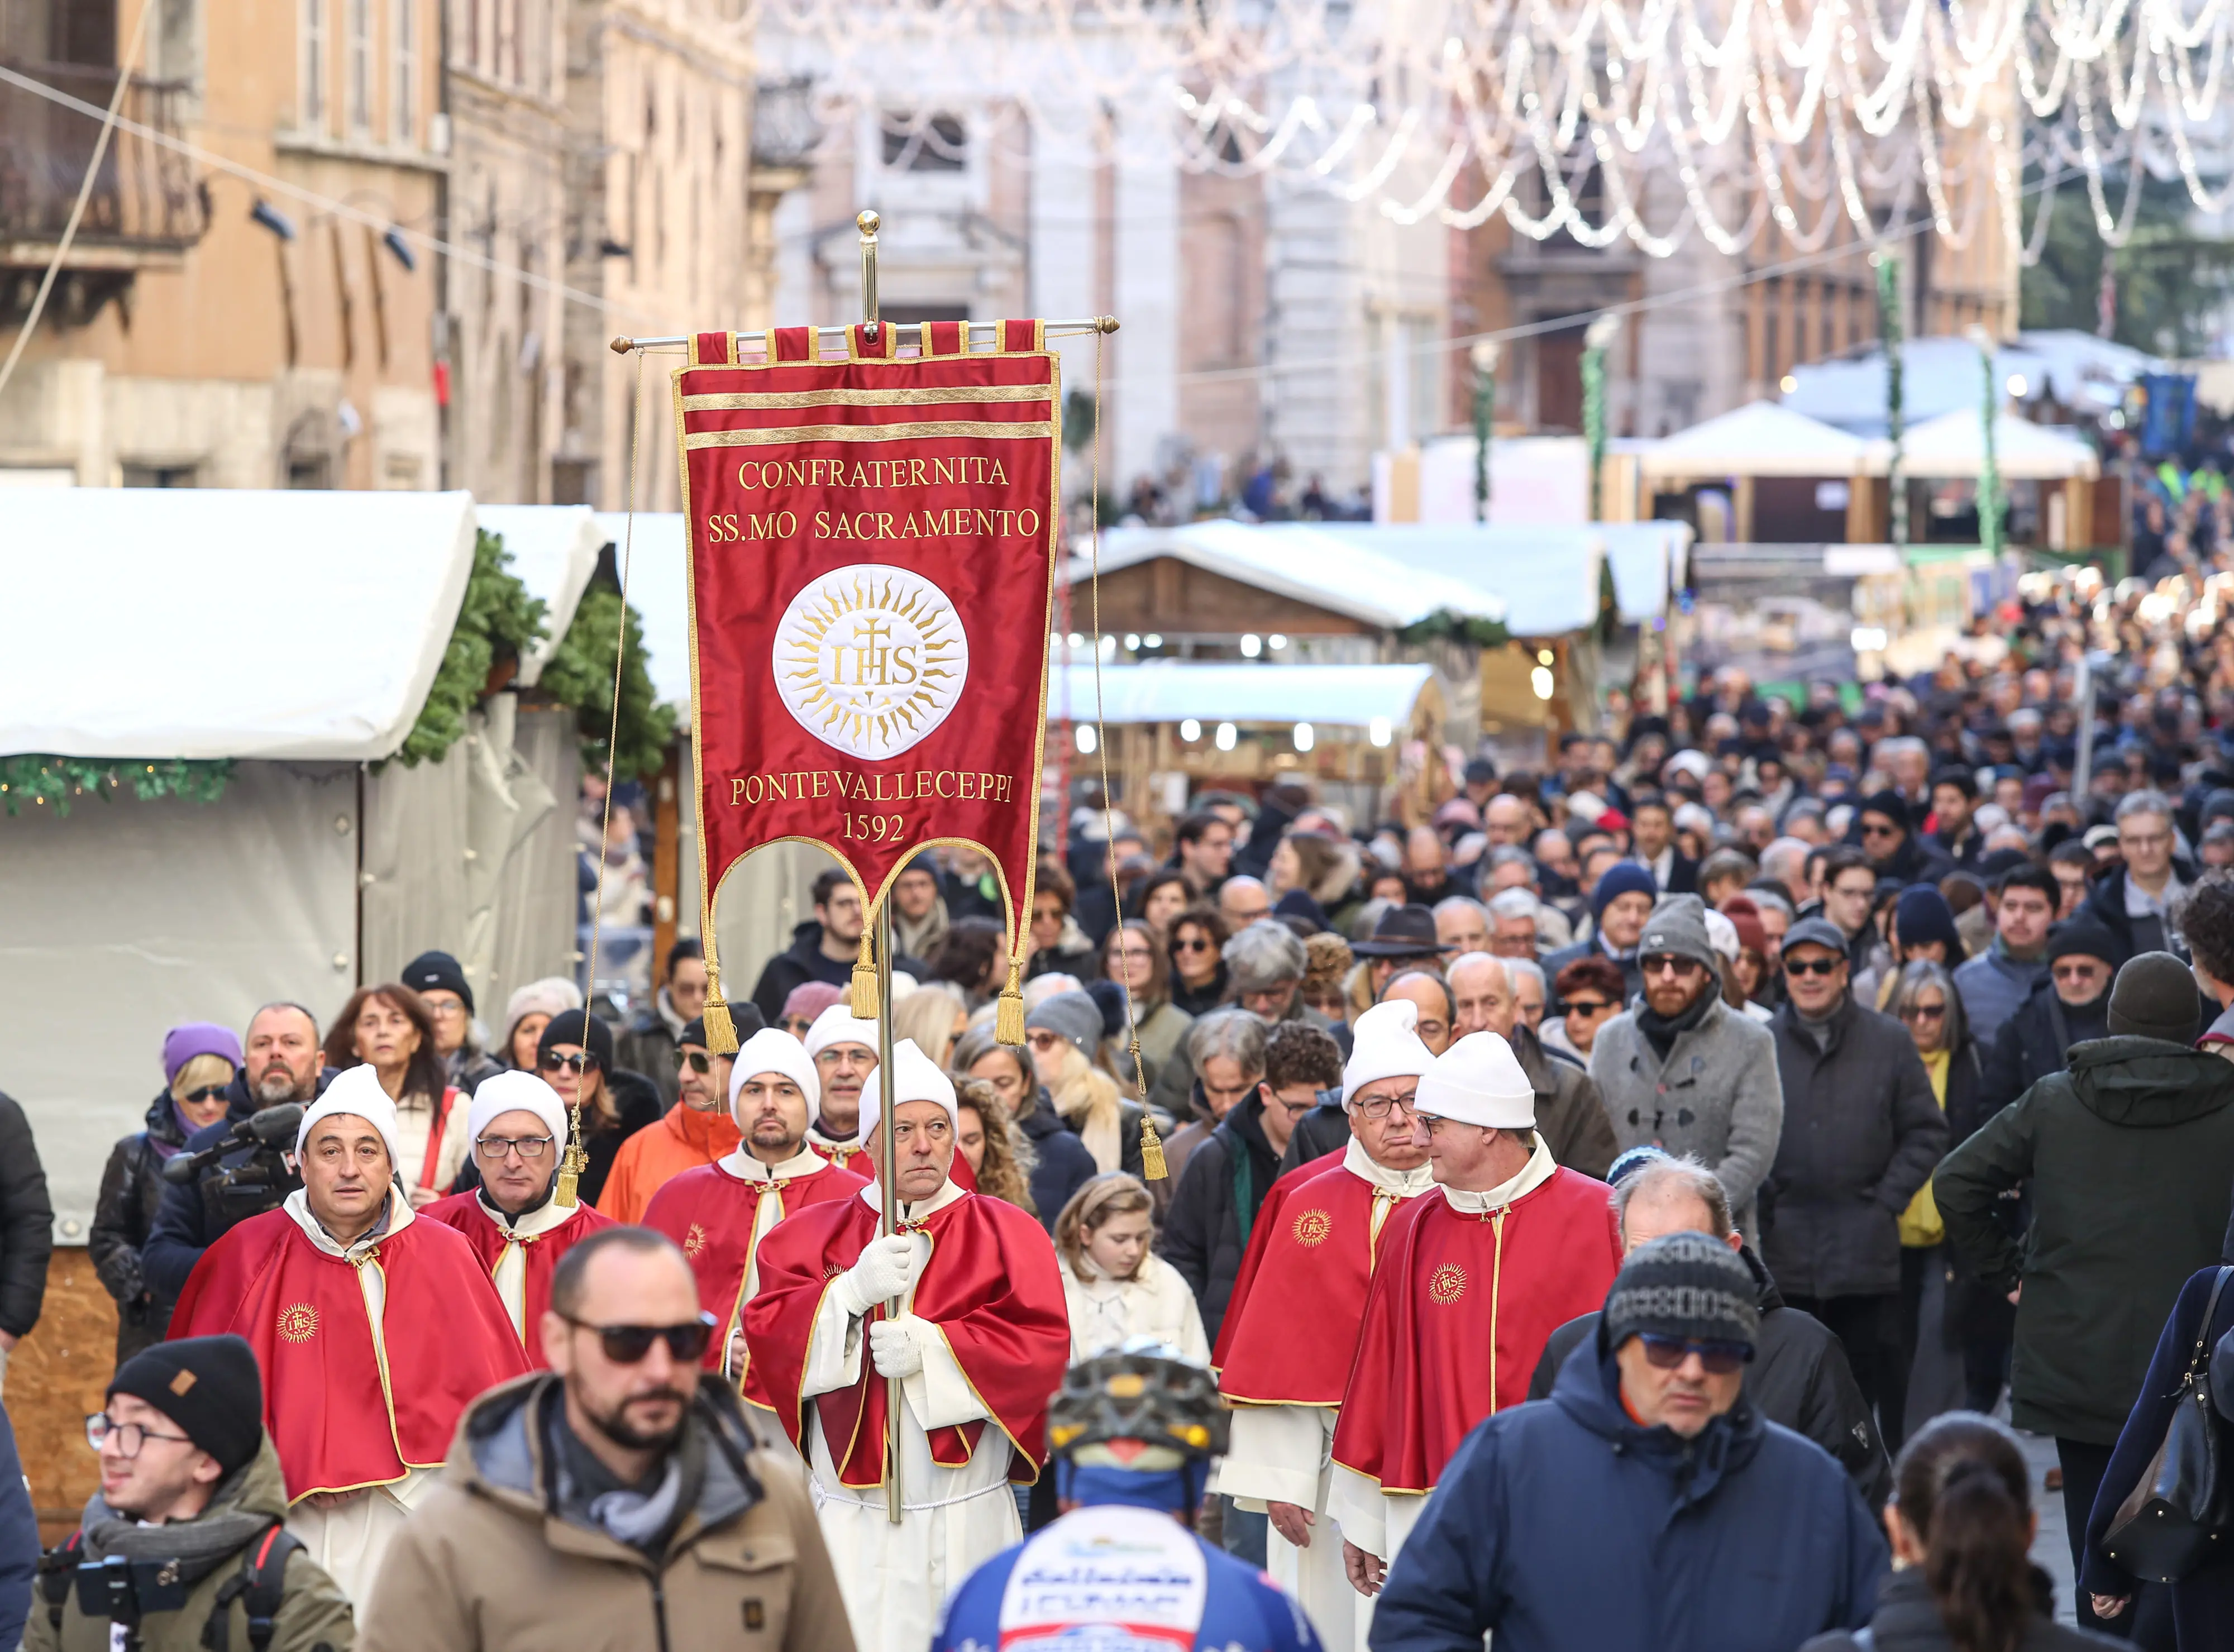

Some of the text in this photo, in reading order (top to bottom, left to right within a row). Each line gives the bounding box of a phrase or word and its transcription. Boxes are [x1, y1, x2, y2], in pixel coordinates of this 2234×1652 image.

[738, 456, 1010, 490] CONFRATERNITA
[708, 508, 1040, 543] SS.MO SACRAMENTO
[830, 644, 917, 686] IHS
[730, 770, 1013, 805] PONTEVALLECEPPI
[843, 811, 905, 842] 1592
[1302, 1223, 1324, 1234] IHS
[1436, 1275, 1458, 1293] IHS
[288, 1316, 311, 1331] IHS
